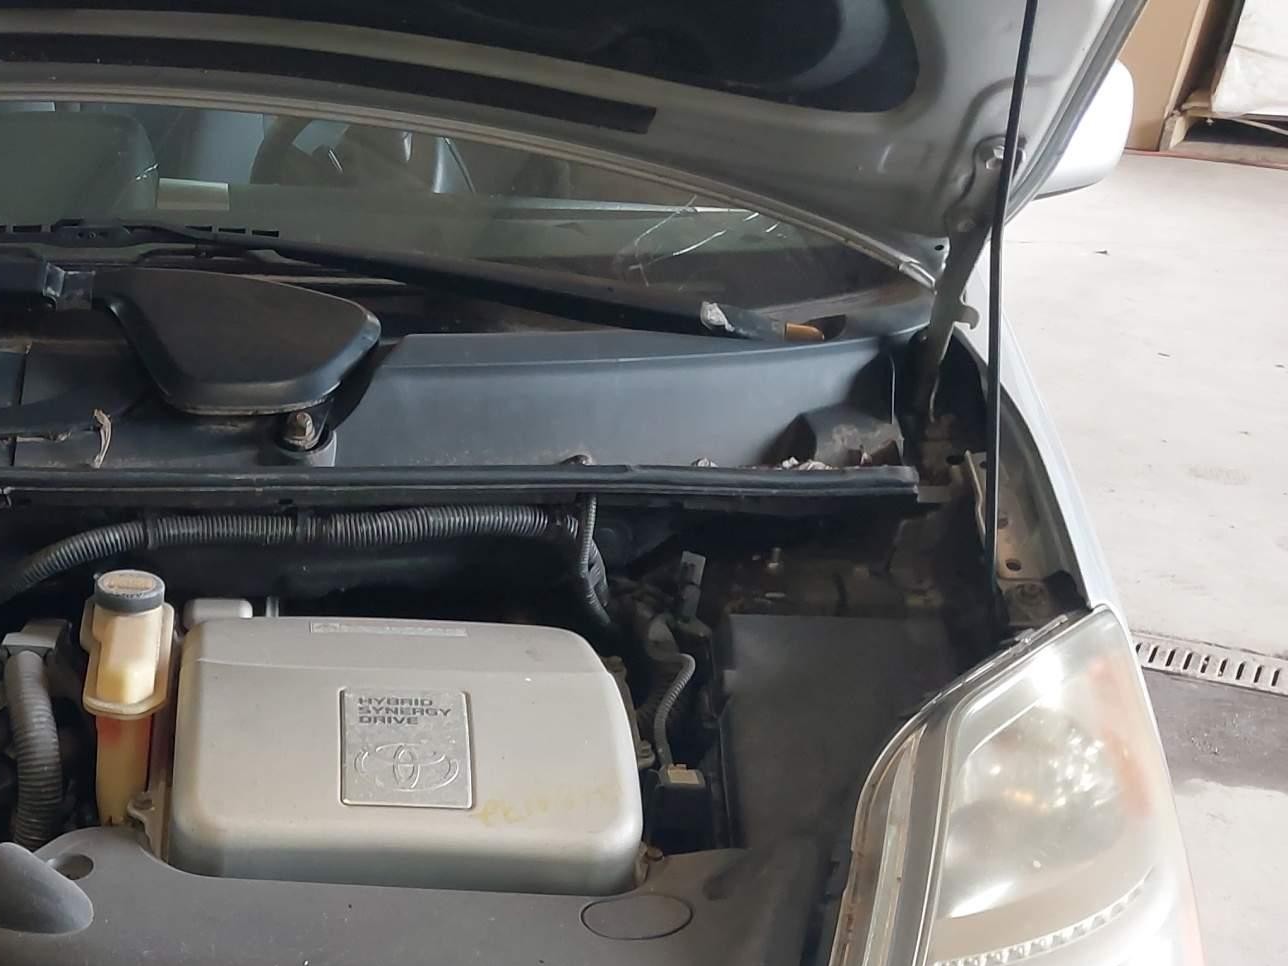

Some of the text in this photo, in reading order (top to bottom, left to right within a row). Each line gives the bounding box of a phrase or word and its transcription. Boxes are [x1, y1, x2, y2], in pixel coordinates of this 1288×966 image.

[358, 697, 433, 706] HYBRID
[358, 706, 452, 716] SYNERGY
[358, 716, 419, 725] DRIVE
